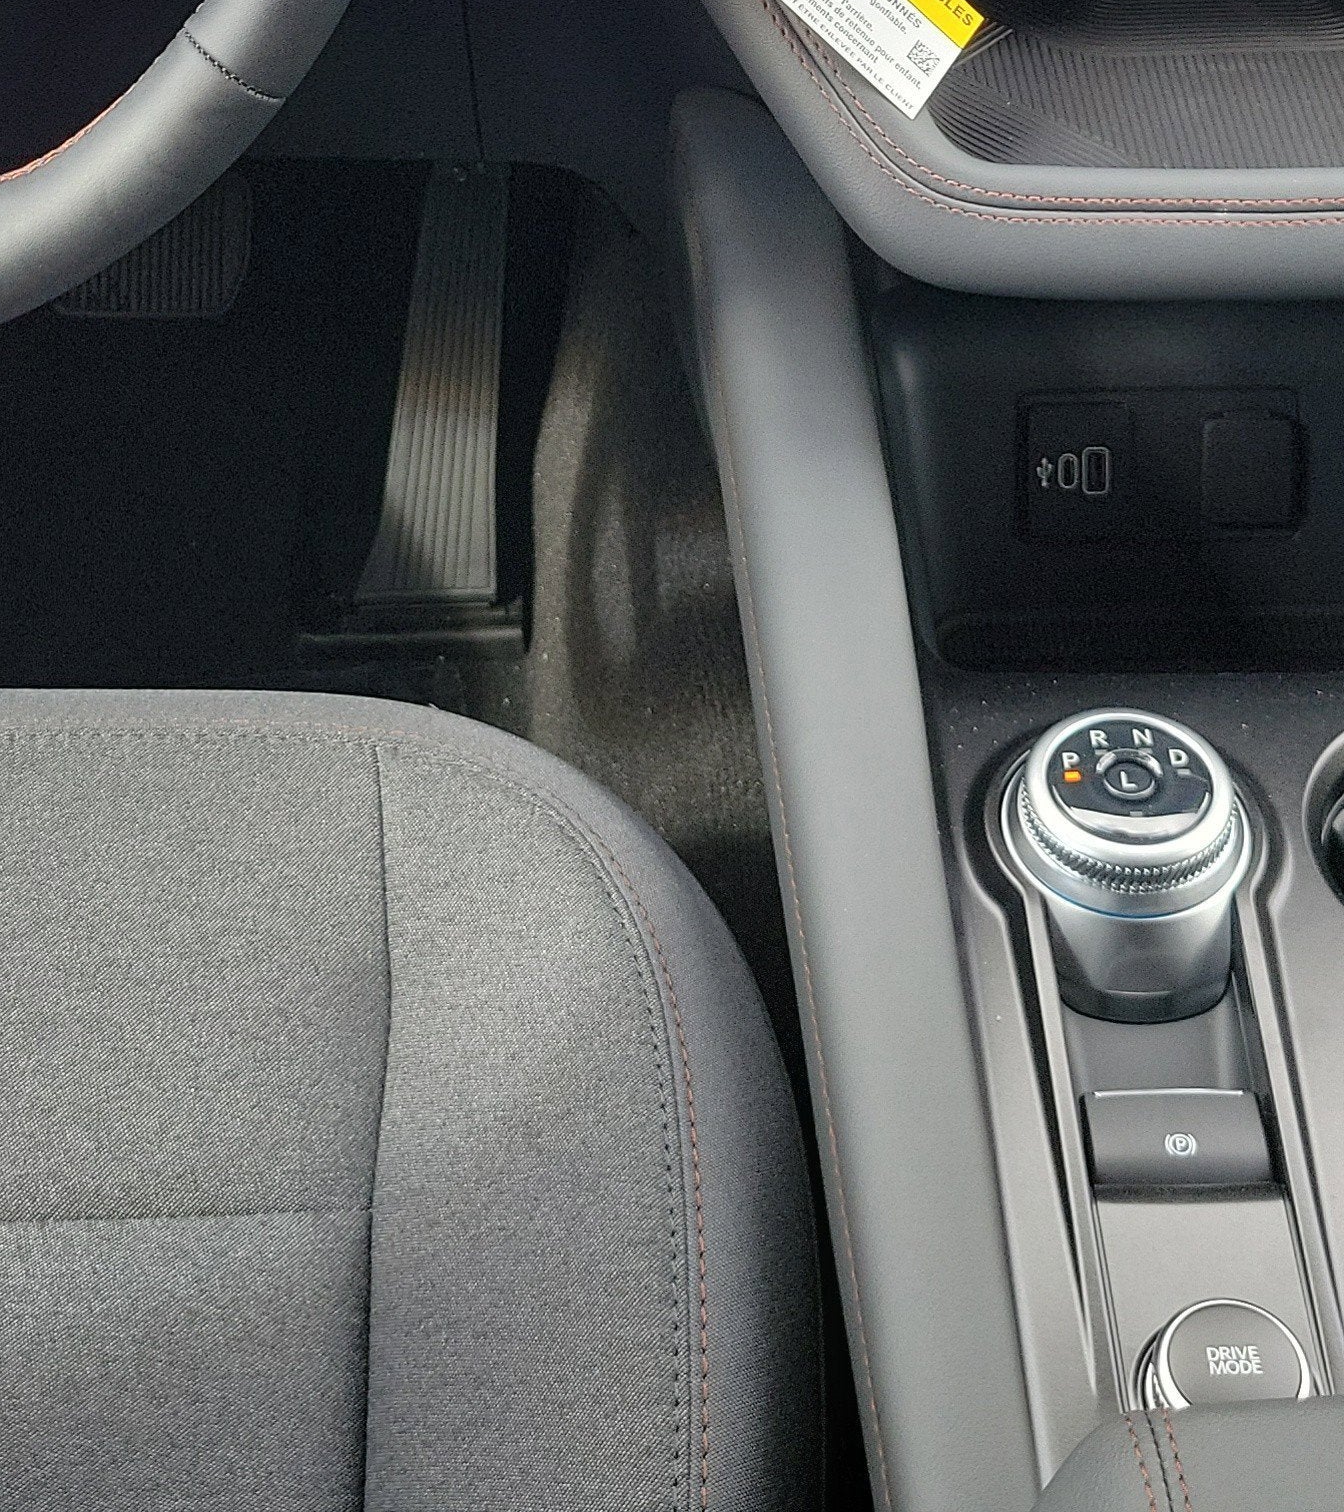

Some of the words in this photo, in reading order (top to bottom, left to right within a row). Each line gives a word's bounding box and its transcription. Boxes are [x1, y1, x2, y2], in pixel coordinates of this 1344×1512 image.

[1089, 729, 1109, 748] R
[1132, 729, 1154, 746] N
[1062, 751, 1080, 769] P
[1168, 748, 1189, 768] D
[1120, 771, 1137, 788] L
[1206, 1345, 1260, 1361] DRIVE
[1209, 1360, 1264, 1375] MODE
